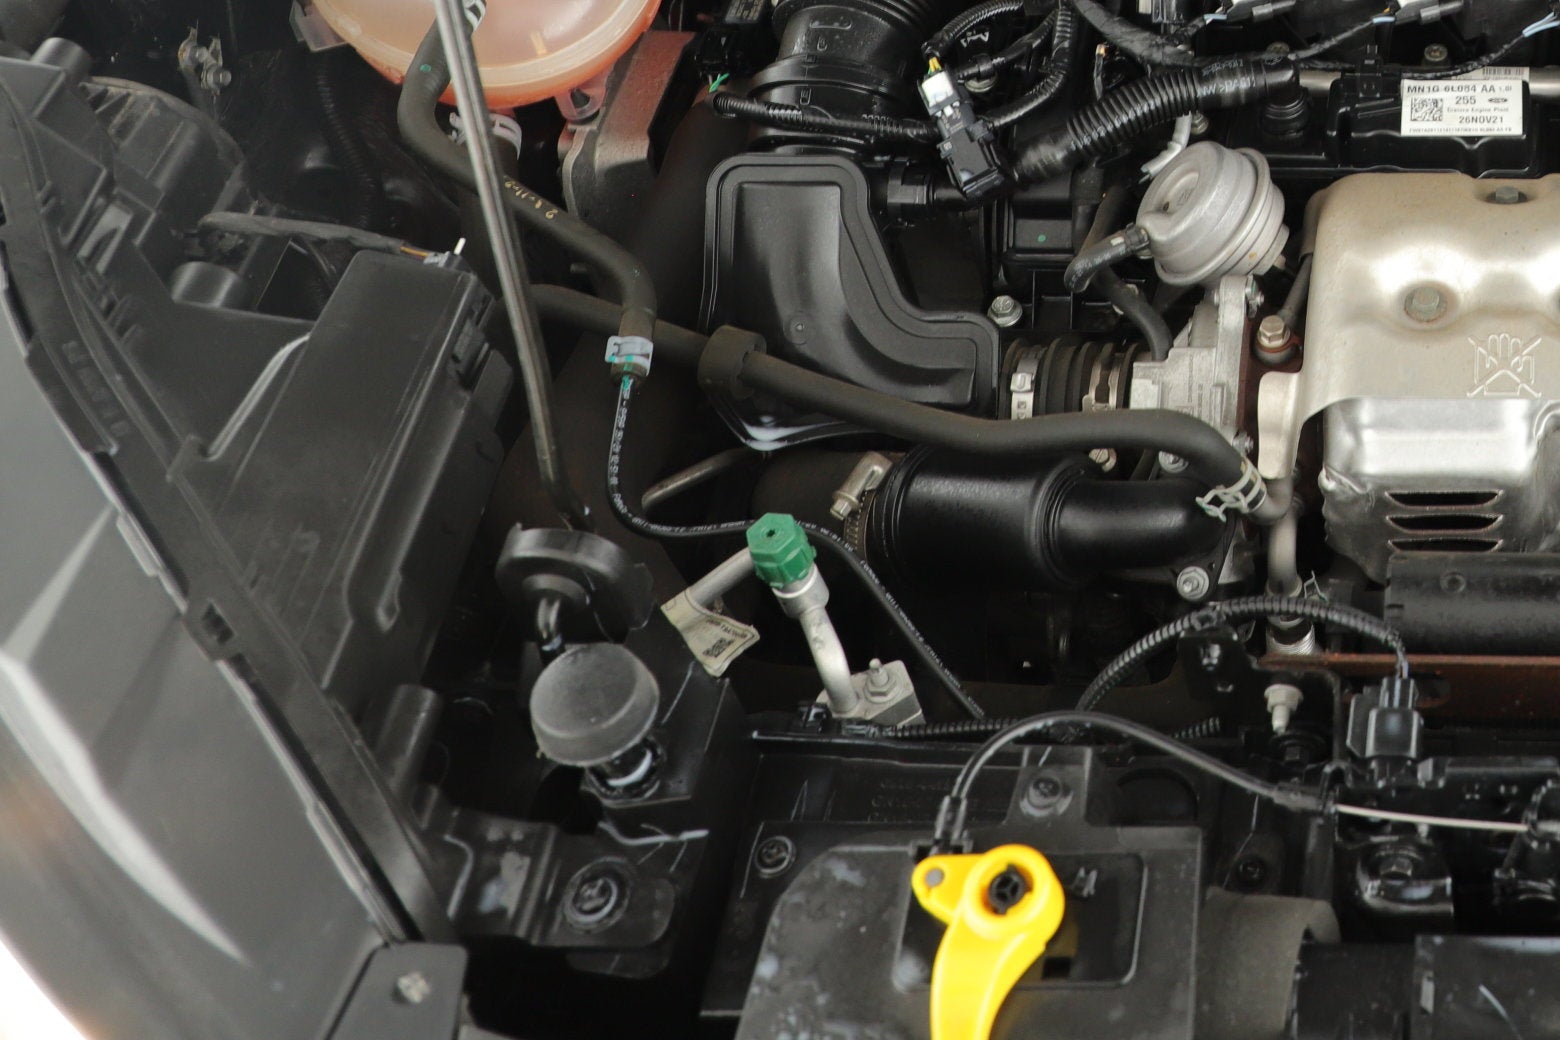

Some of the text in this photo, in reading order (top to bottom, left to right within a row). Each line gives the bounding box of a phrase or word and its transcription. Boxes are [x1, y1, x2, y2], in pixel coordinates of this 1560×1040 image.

[1480, 84, 1496, 93] AA
[1455, 96, 1477, 105] 255
[1458, 115, 1504, 124] 26NOV21
